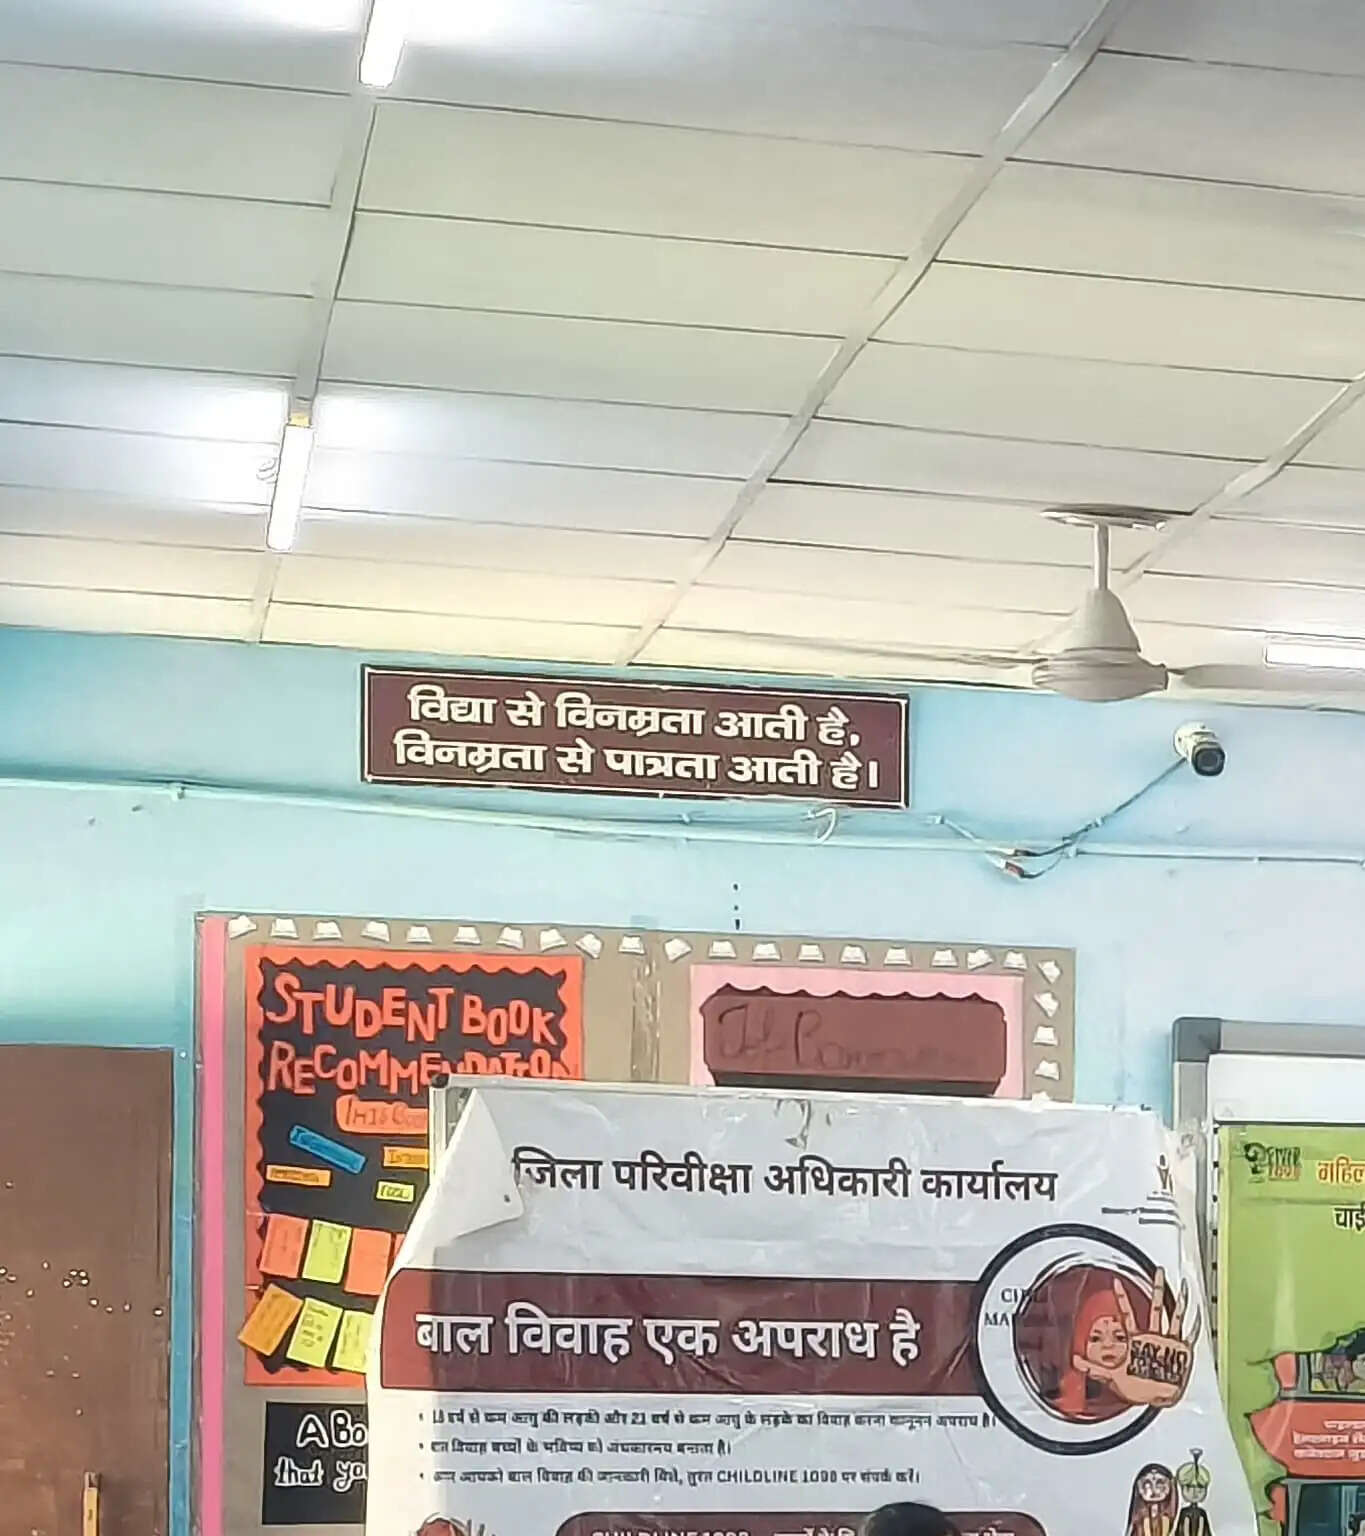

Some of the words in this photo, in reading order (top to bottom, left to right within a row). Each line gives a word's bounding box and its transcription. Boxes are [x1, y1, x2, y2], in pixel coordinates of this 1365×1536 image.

[408, 685, 494, 725] विद्या
[505, 690, 544, 727] से
[555, 692, 703, 738] विनम्रता
[714, 703, 808, 741] आती
[817, 706, 861, 746] है,
[393, 729, 546, 774] विनम्रता
[556, 738, 595, 773] से
[604, 750, 717, 781] पात्रता
[727, 749, 822, 786] आती
[831, 753, 880, 789] है।
[265, 971, 455, 1043] STUDENT
[461, 994, 558, 1046] BOOK
[512, 1146, 603, 1191] जिला
[612, 1149, 753, 1194] परिवीक्षा
[763, 1154, 912, 1200] अधिकारी
[920, 1160, 1058, 1202] कार्यालय
[416, 1313, 494, 1355] बाल
[504, 1301, 633, 1363] विवाह
[643, 1318, 719, 1364] एक
[731, 1320, 880, 1360] अपराध
[889, 1307, 920, 1367] है
[296, 1413, 329, 1448] A
[273, 1456, 324, 1487] that
[717, 1471, 797, 1484] CHILDLINE
[802, 1471, 837, 1484] 1098
